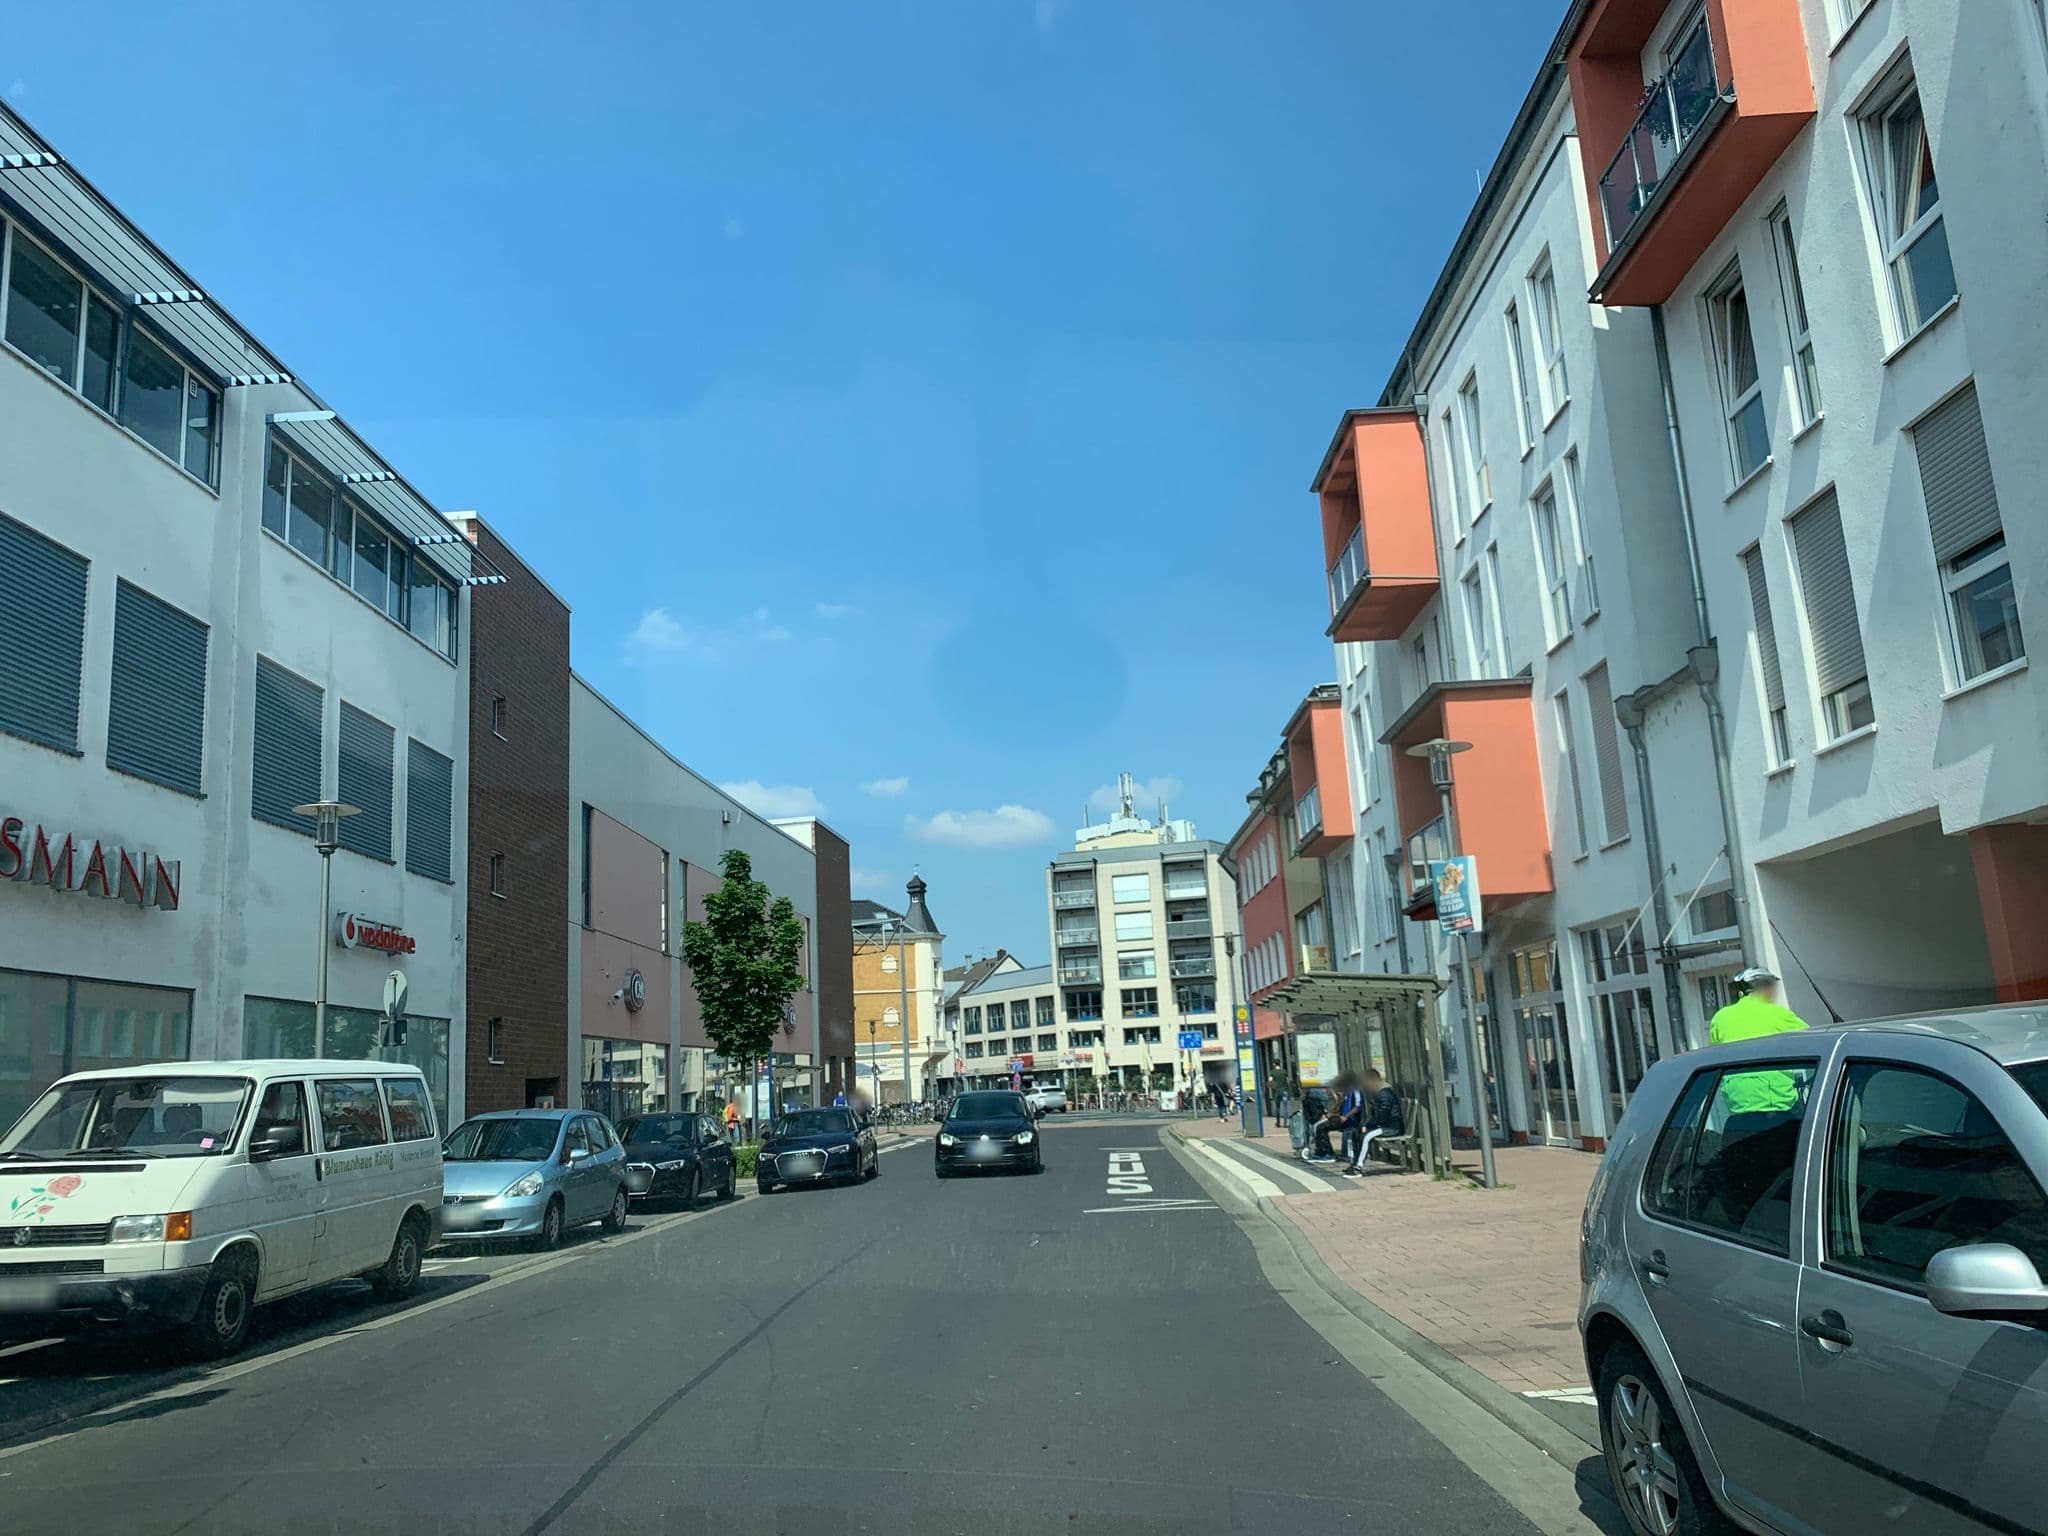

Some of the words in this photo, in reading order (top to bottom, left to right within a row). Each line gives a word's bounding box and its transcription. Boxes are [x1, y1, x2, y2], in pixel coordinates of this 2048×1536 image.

[0, 817, 181, 911] SMANN
[359, 924, 416, 954] vodafone
[1704, 988, 1717, 1008] 99
[324, 1154, 373, 1176] Blumenhaus
[374, 1149, 394, 1171] König
[1106, 1152, 1154, 1194] BUS
